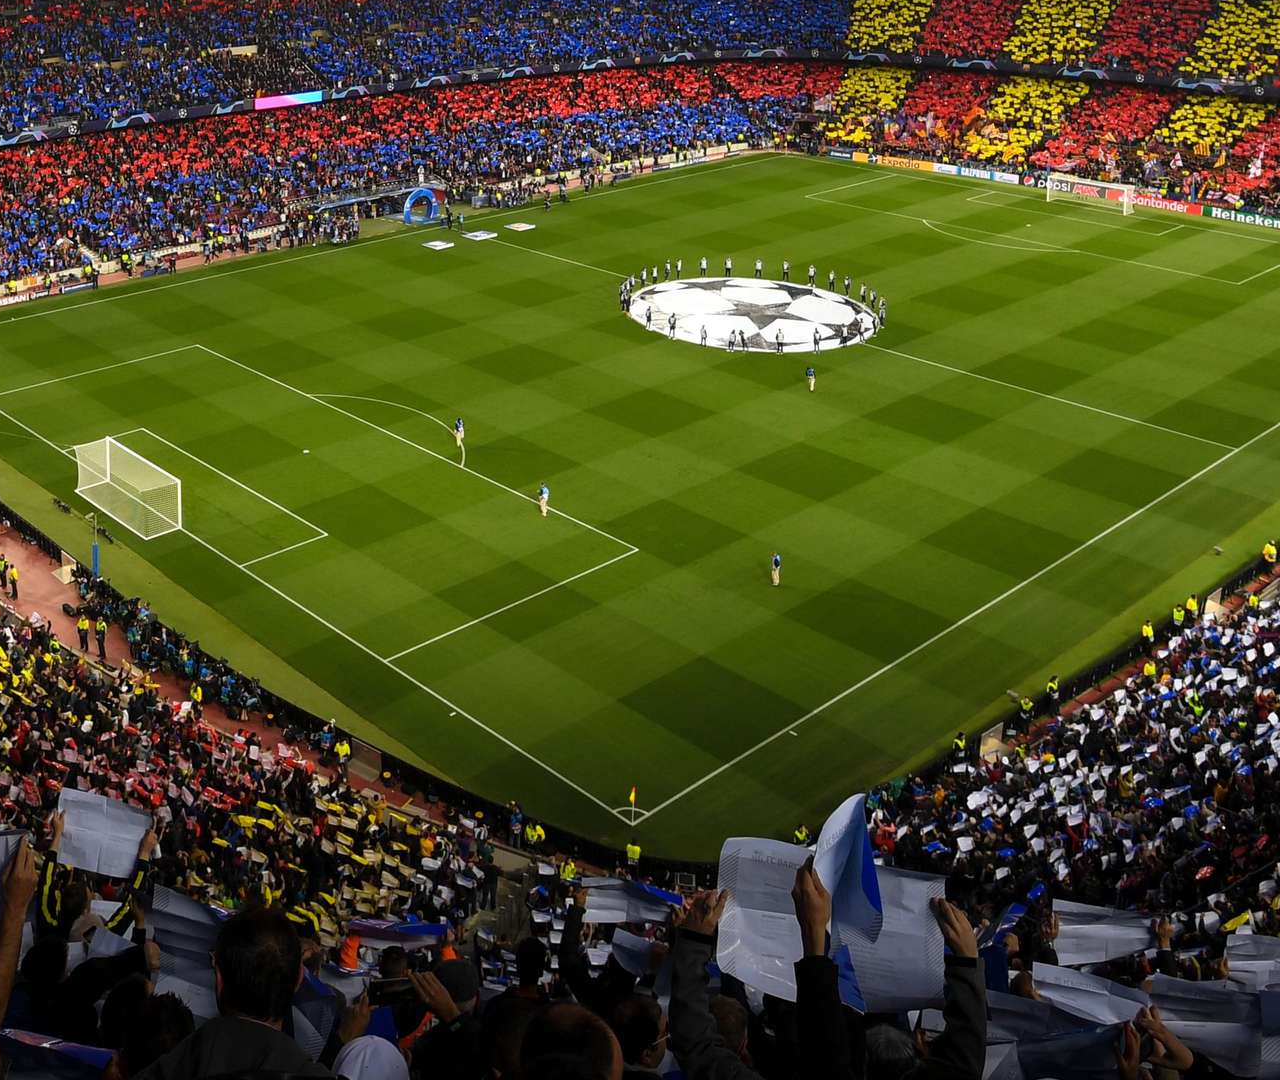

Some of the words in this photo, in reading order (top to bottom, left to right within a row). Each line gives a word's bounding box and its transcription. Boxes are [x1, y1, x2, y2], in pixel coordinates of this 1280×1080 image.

[881, 155, 920, 170] Expedia
[1037, 179, 1071, 193] pepsi
[1130, 193, 1189, 214] Santander
